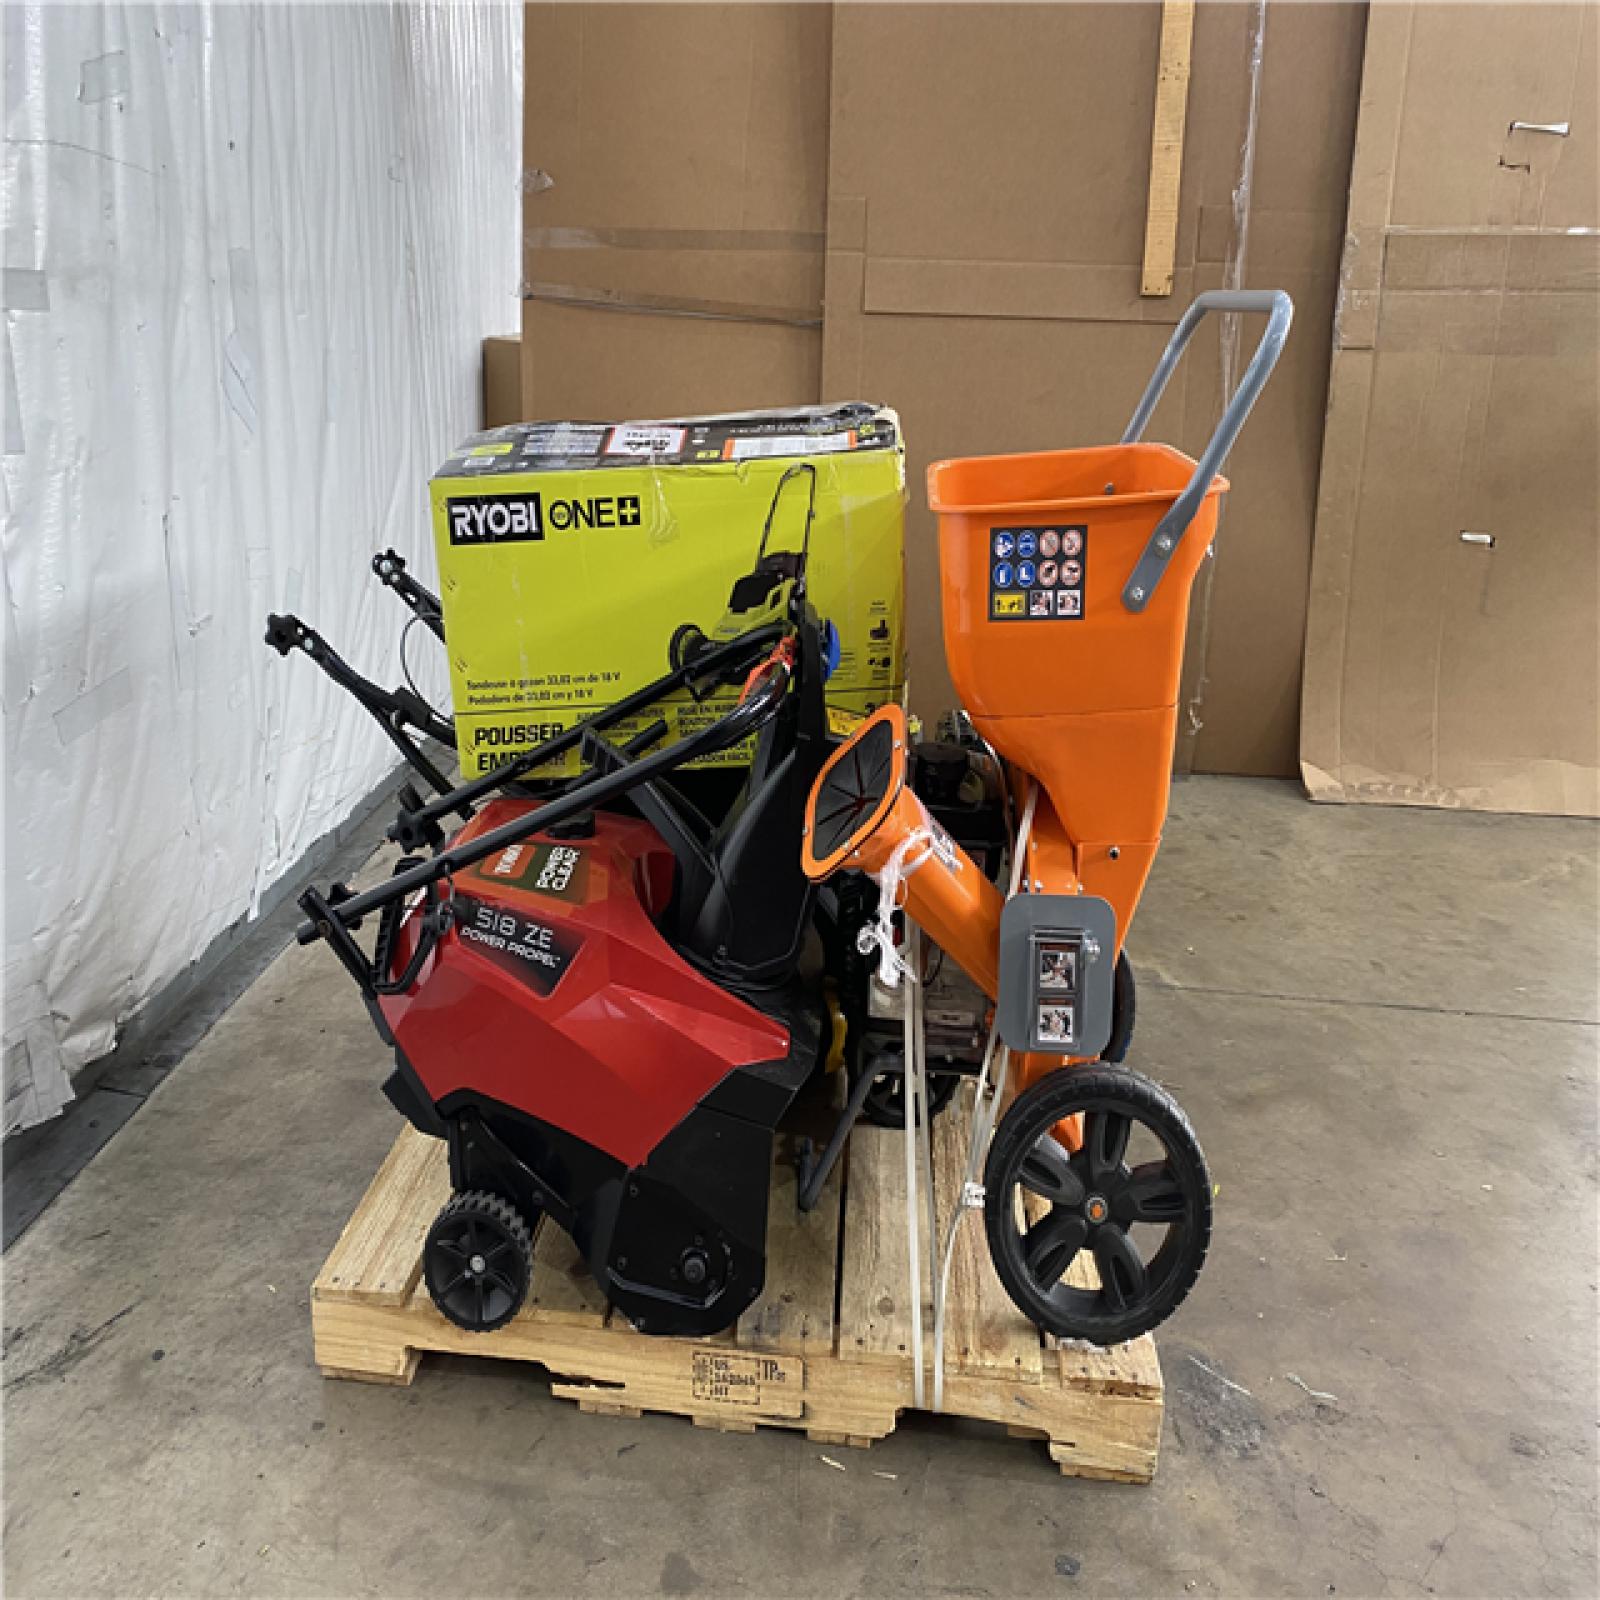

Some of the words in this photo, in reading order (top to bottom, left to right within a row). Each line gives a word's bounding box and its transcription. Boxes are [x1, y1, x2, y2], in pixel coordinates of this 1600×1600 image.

[451, 501, 538, 538] RYOBI
[552, 849, 581, 890] CLEAR
[460, 926, 506, 949] POWER
[522, 922, 554, 950] ZE
